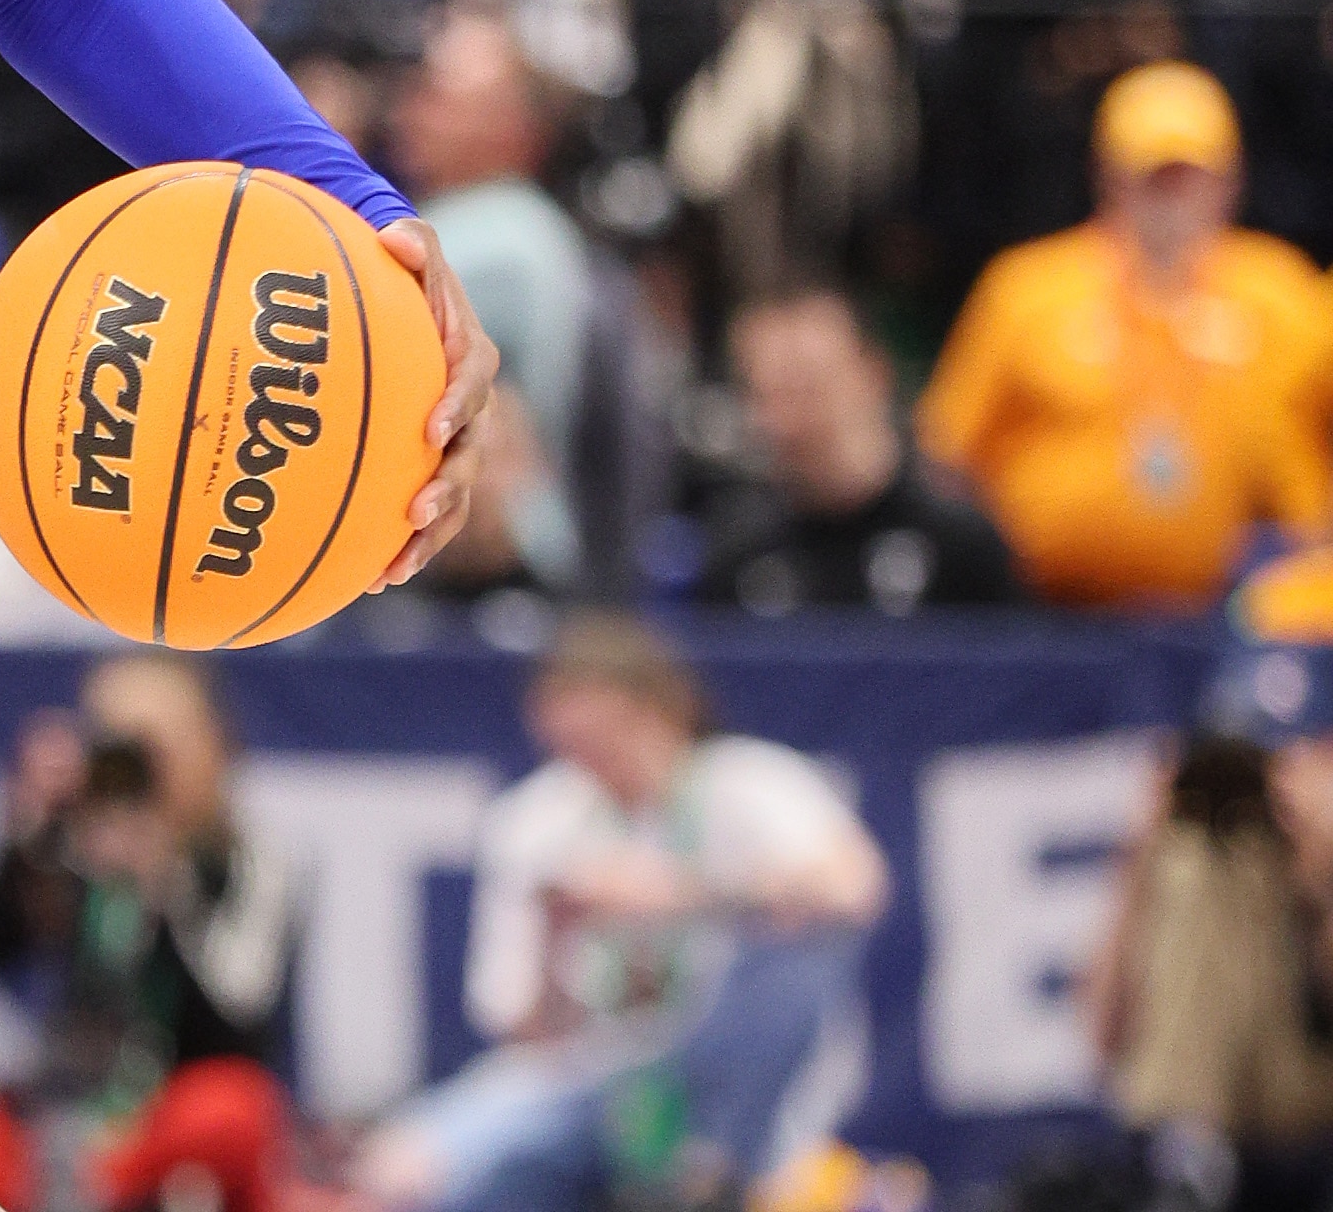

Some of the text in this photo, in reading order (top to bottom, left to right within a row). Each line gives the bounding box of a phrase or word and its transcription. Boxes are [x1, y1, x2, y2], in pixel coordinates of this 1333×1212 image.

[56, 372, 73, 435] GAME
[70, 275, 170, 514] NCAA
[195, 269, 330, 580] Wilson
[54, 443, 68, 499] BALL
[204, 462, 220, 496] BALL
